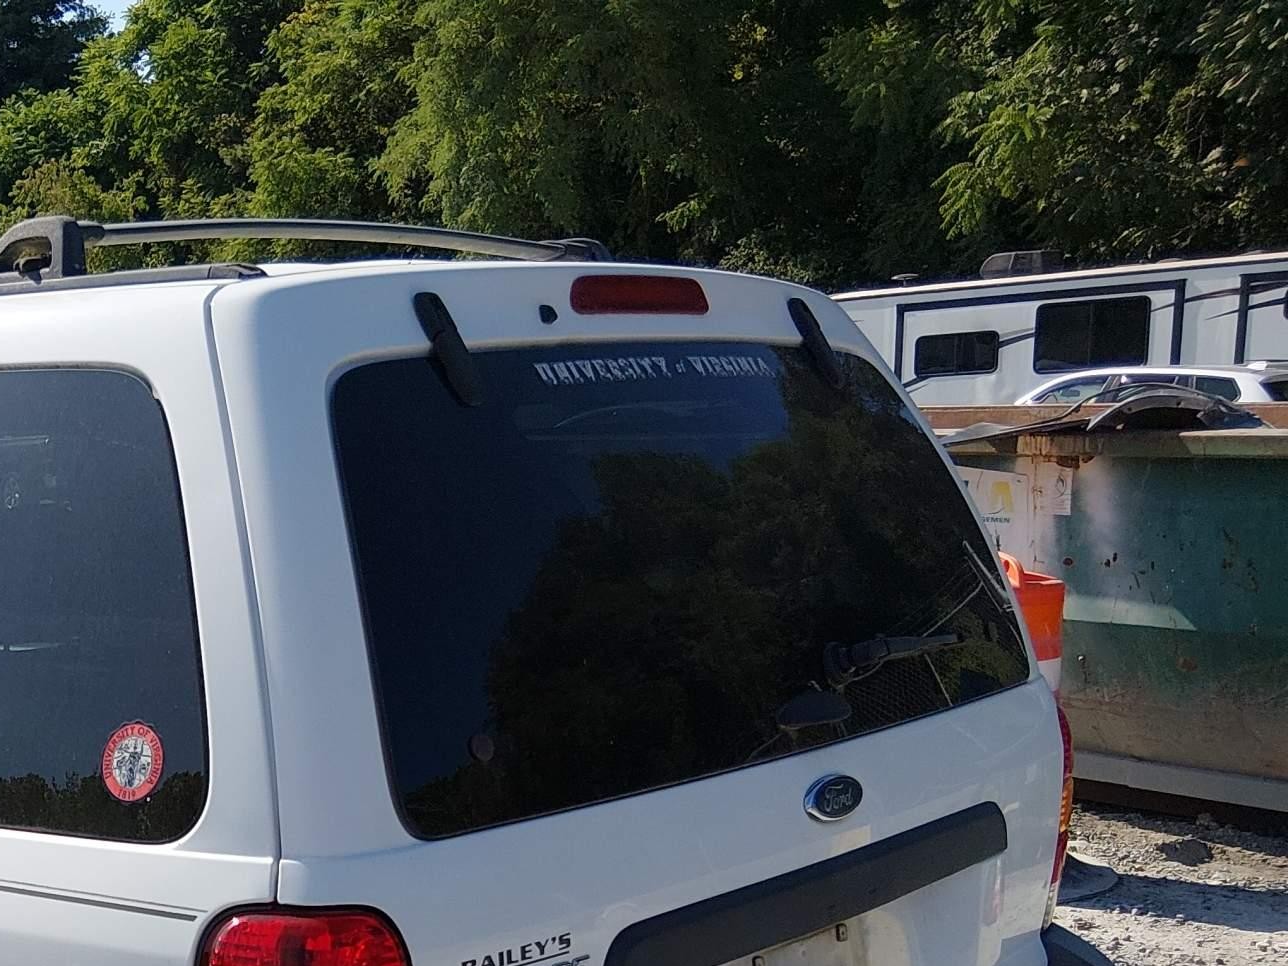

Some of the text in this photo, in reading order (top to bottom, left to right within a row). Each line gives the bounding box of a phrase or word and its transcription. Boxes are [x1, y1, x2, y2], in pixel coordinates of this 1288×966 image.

[533, 356, 672, 385] UNIVERSITY
[687, 356, 776, 378] VIRGINIA
[104, 726, 163, 785] UNIVERSITY OF VIRGINIA
